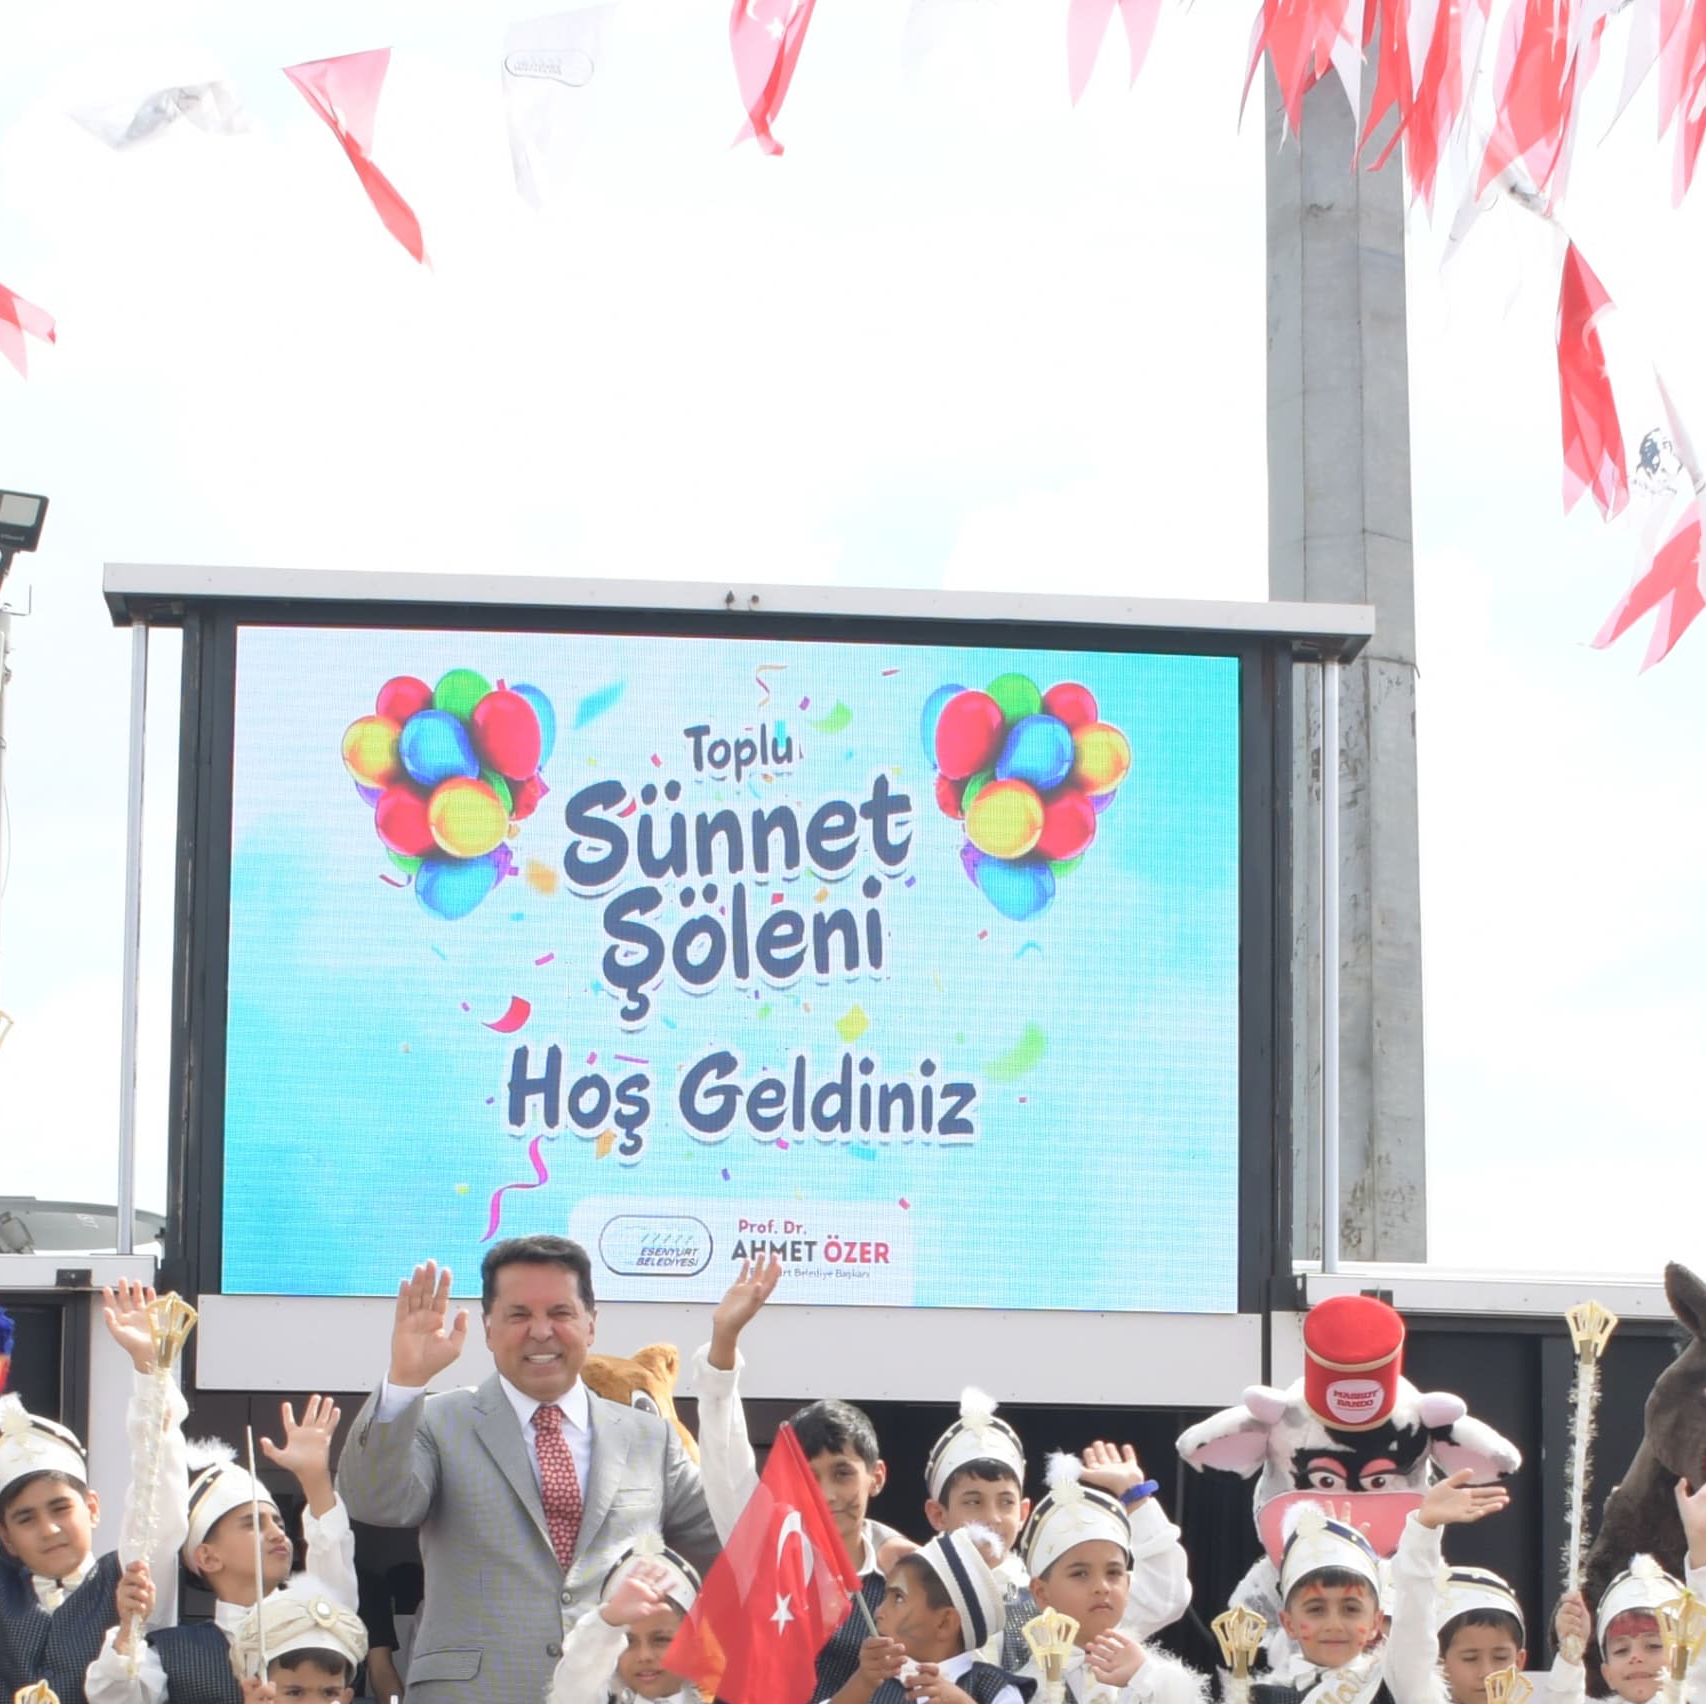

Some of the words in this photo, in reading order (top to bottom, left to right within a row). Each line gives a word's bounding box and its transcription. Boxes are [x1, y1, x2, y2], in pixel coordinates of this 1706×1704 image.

[683, 724, 793, 782] Toplu
[563, 774, 912, 887] Sünnet
[602, 876, 883, 1022] Şöleni
[507, 1045, 651, 1156] Hoş
[678, 1051, 977, 1136] Geldiniz
[731, 1239, 818, 1262] AHMET
[824, 1234, 890, 1264] ÖZER
[738, 1219, 778, 1234] Prof.
[784, 1220, 807, 1235] Dr.
[794, 1268, 834, 1280] Belediye
